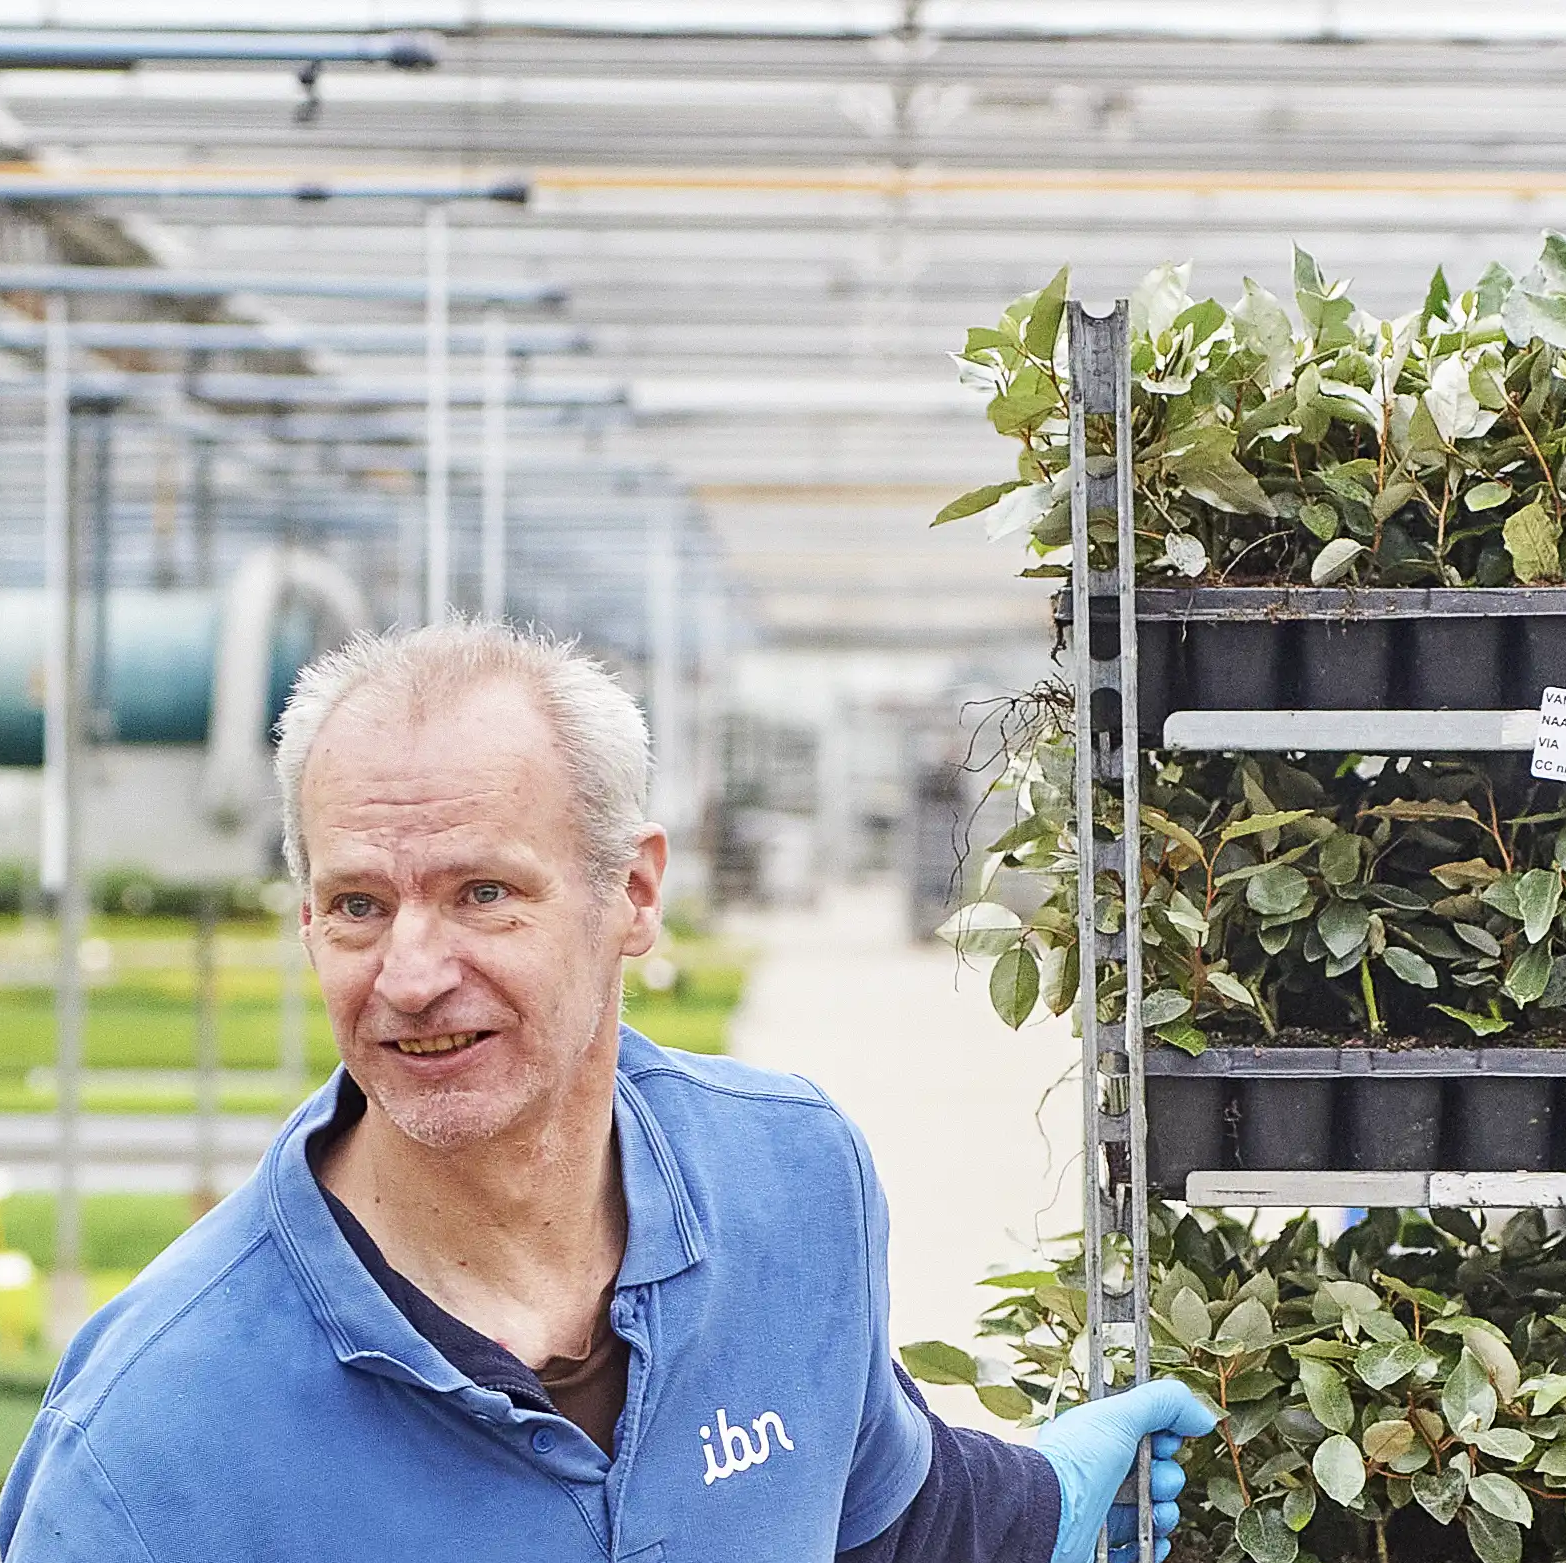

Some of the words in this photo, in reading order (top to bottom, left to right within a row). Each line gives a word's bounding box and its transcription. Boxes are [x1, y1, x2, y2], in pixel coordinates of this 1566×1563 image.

[1538, 736, 1559, 750] VIA
[1534, 759, 1553, 771] CC
[699, 1408, 795, 1486] ibn
